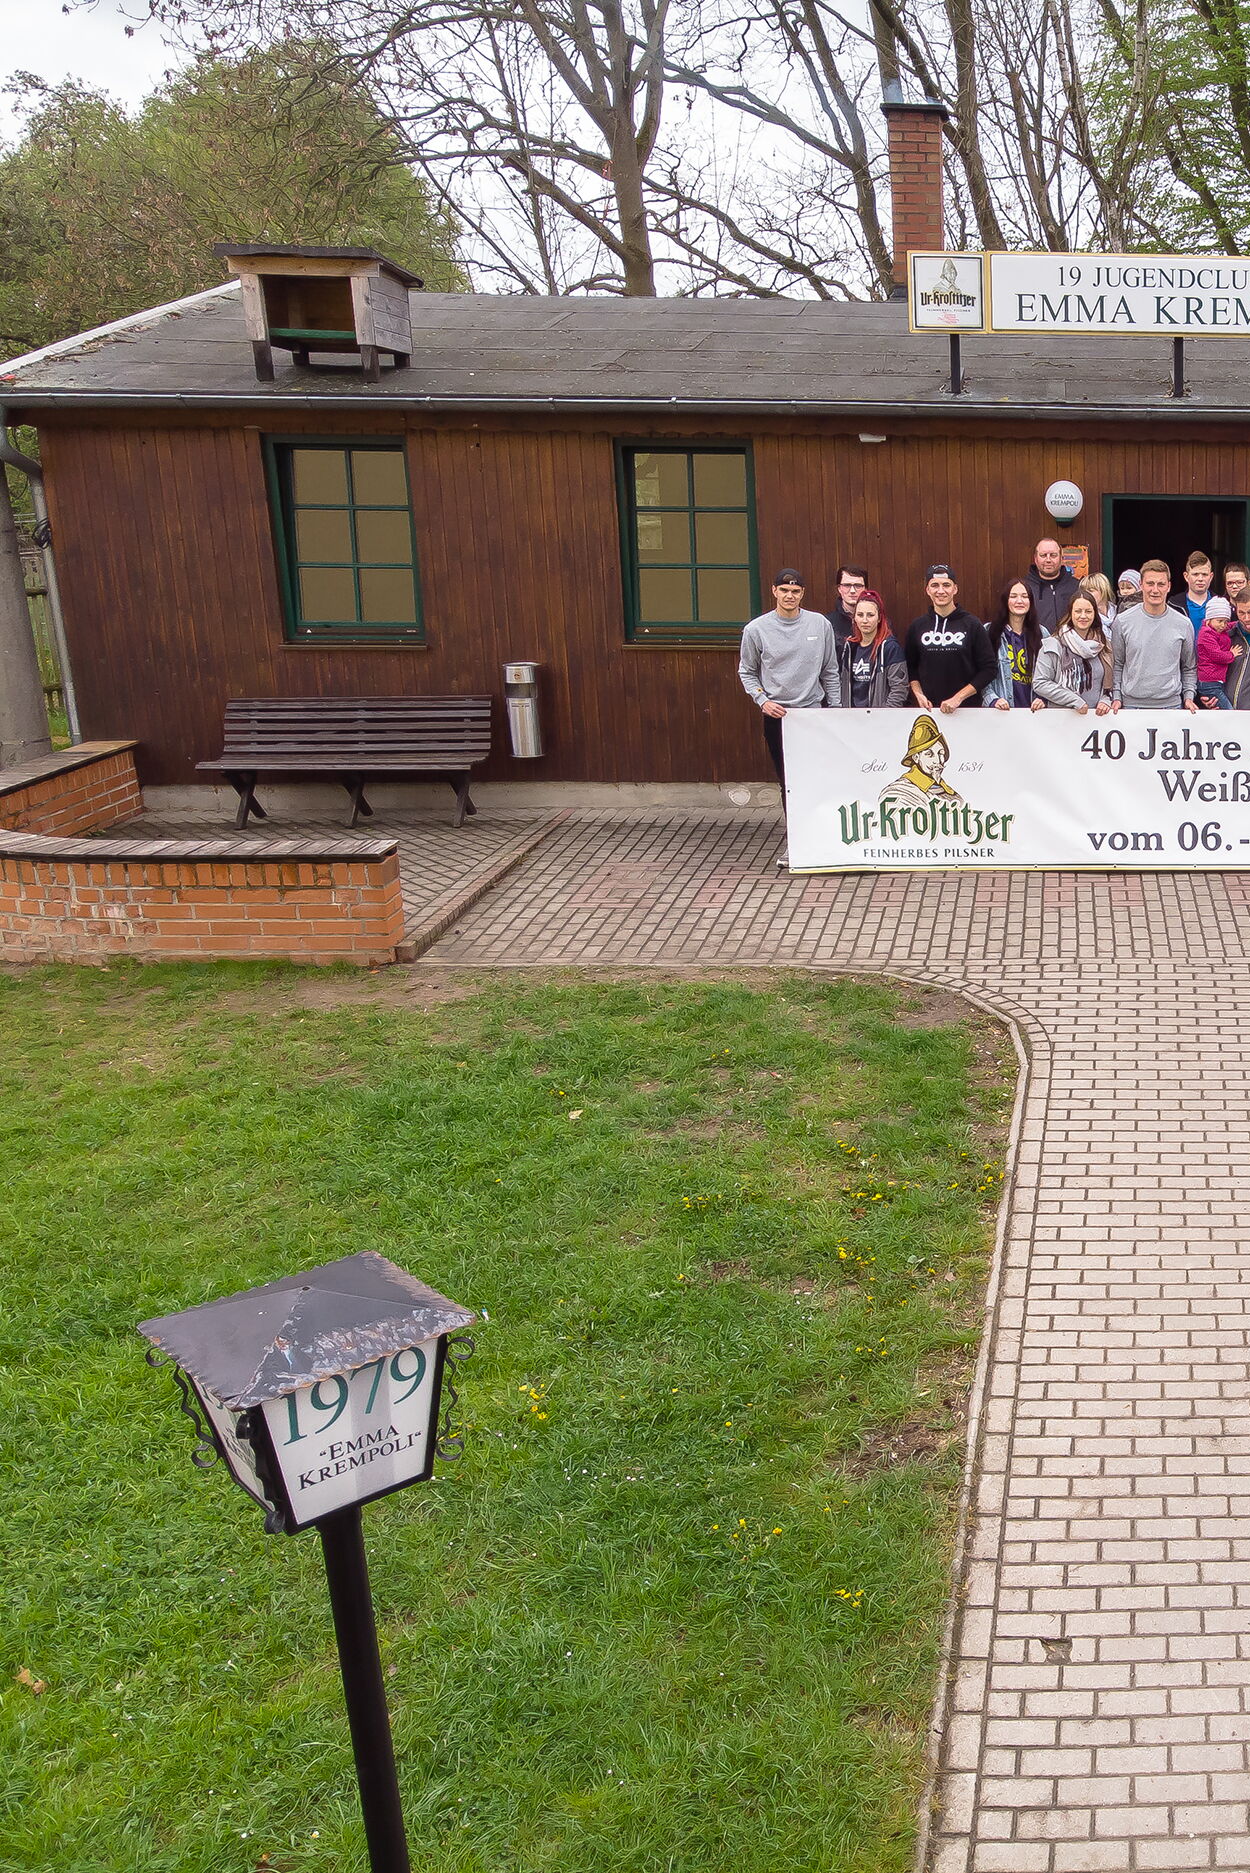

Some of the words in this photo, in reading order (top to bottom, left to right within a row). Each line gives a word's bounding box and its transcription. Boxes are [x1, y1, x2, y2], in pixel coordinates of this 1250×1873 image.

[1059, 266, 1082, 287] 19
[1015, 293, 1137, 324] EMMA
[921, 630, 966, 646] dope
[1081, 730, 1125, 760] 40
[1138, 728, 1242, 761] Jahre
[861, 758, 889, 774] Seit
[1087, 831, 1164, 851] vom
[863, 848, 938, 859] FEINHERBES
[944, 848, 995, 859] PILSNER
[283, 1346, 427, 1446] 1979
